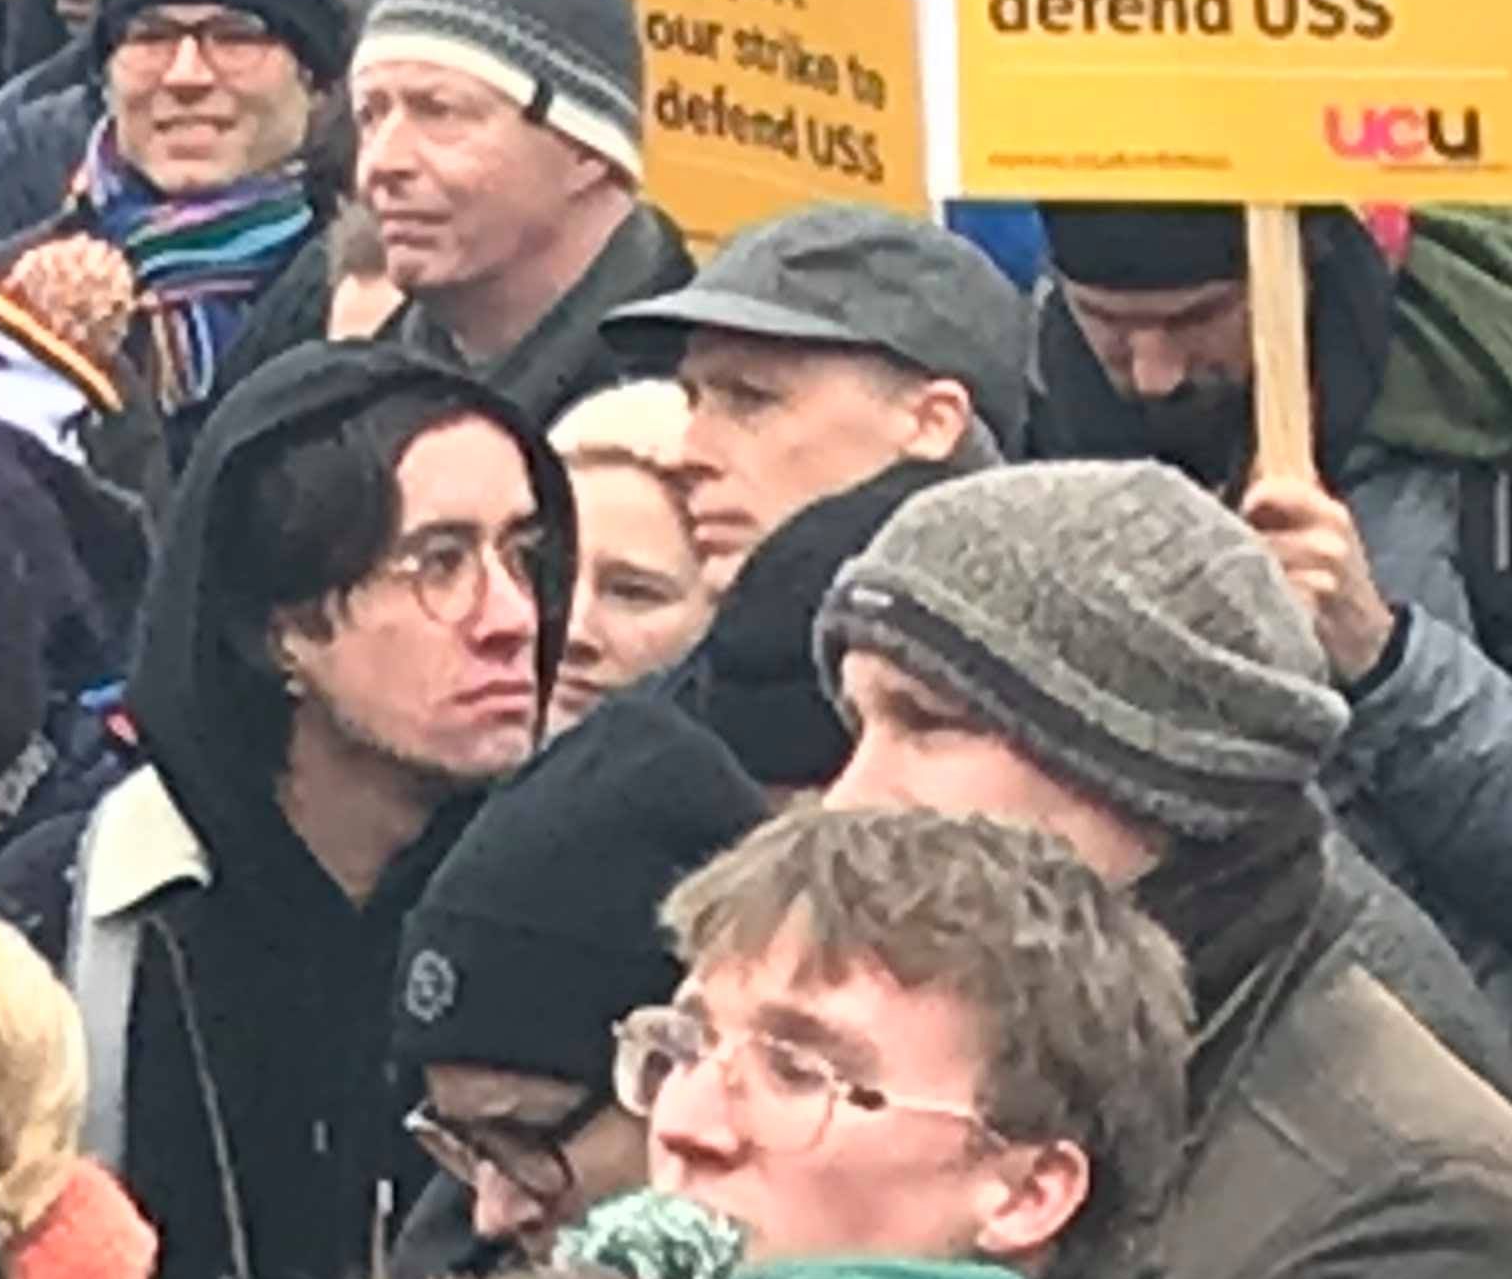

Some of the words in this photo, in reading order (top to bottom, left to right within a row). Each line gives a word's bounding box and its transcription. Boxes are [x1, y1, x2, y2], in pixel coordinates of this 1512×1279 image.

[647, 12, 724, 60] our
[734, 25, 840, 96] strike
[848, 53, 885, 111] to
[654, 79, 798, 161] defend
[808, 115, 885, 184] USS
